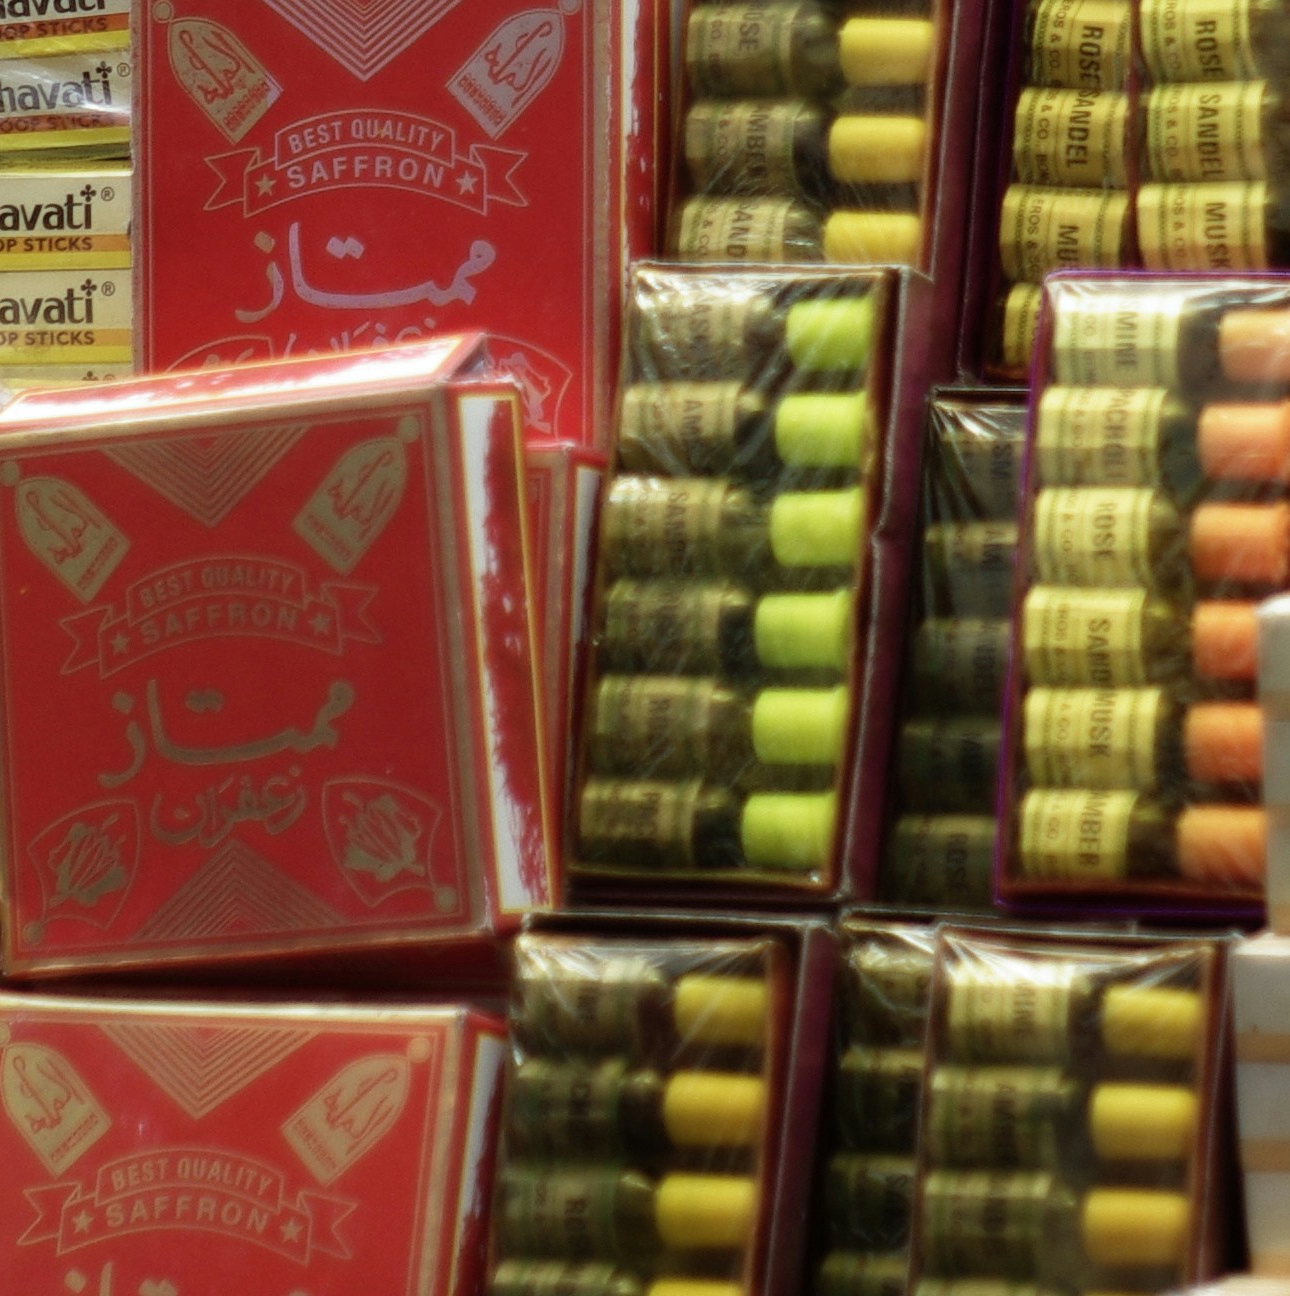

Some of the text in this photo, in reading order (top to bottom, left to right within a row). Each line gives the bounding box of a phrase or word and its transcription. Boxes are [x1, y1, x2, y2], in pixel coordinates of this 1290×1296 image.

[288, 117, 446, 154] BEST QUALITY
[1066, 89, 1094, 168] SANDEL
[286, 155, 446, 189] SAFFRON
[22, 236, 93, 253] STICKS
[112, 1156, 273, 1192] BEST QUALITY
[107, 1193, 268, 1234] SAFFRON
